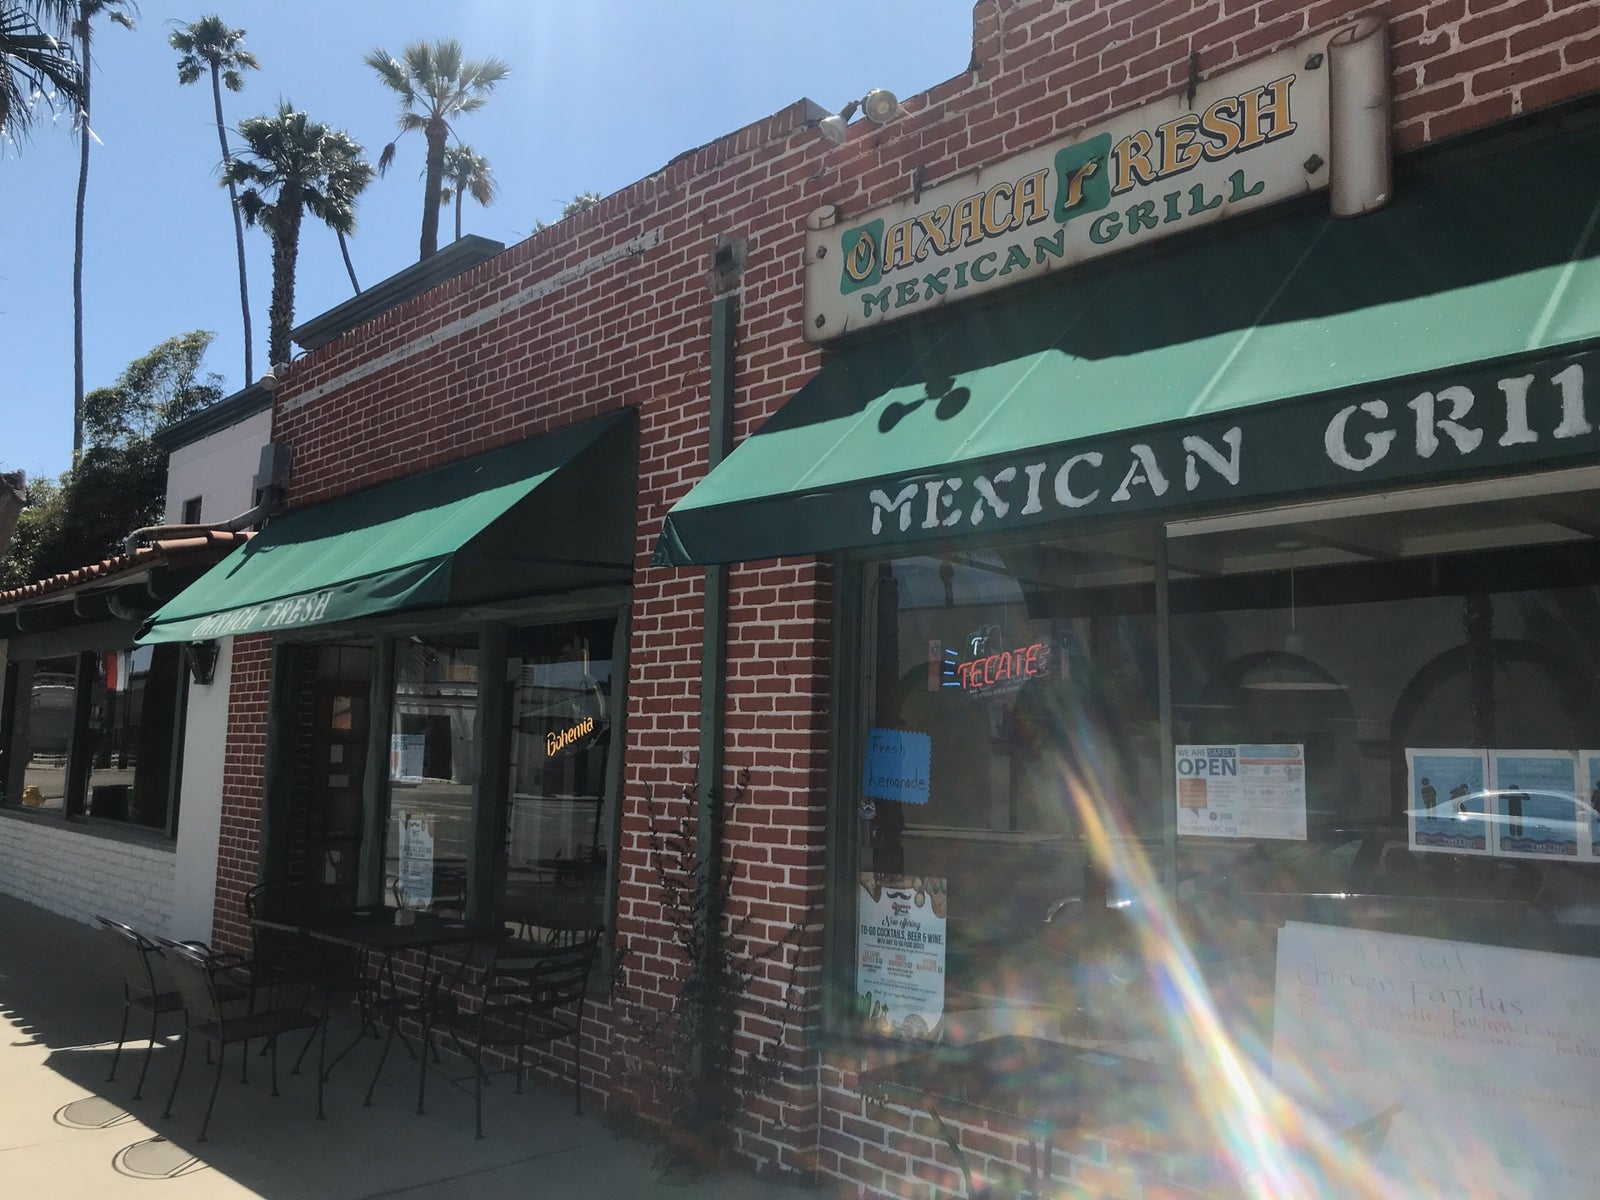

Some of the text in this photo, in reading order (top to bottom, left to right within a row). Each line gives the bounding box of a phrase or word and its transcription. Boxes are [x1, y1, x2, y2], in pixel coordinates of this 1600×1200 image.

[846, 74, 1298, 281] OAXACA FRESH
[861, 169, 1265, 318] MEXICAN GRILL
[869, 426, 1243, 536] MEXICAN
[262, 592, 334, 628] FRESH
[957, 643, 1042, 690] TECATE
[547, 716, 594, 756] Bohemia
[872, 735, 906, 756] Fresh
[1178, 748, 1190, 757] WE
[1192, 748, 1206, 757] ARE
[1207, 748, 1236, 757] SAFELY
[1177, 758, 1237, 776] OPEN
[861, 925, 876, 936] TO-GO
[877, 927, 906, 941] COCKTAILS,
[907, 931, 922, 942] BEER
